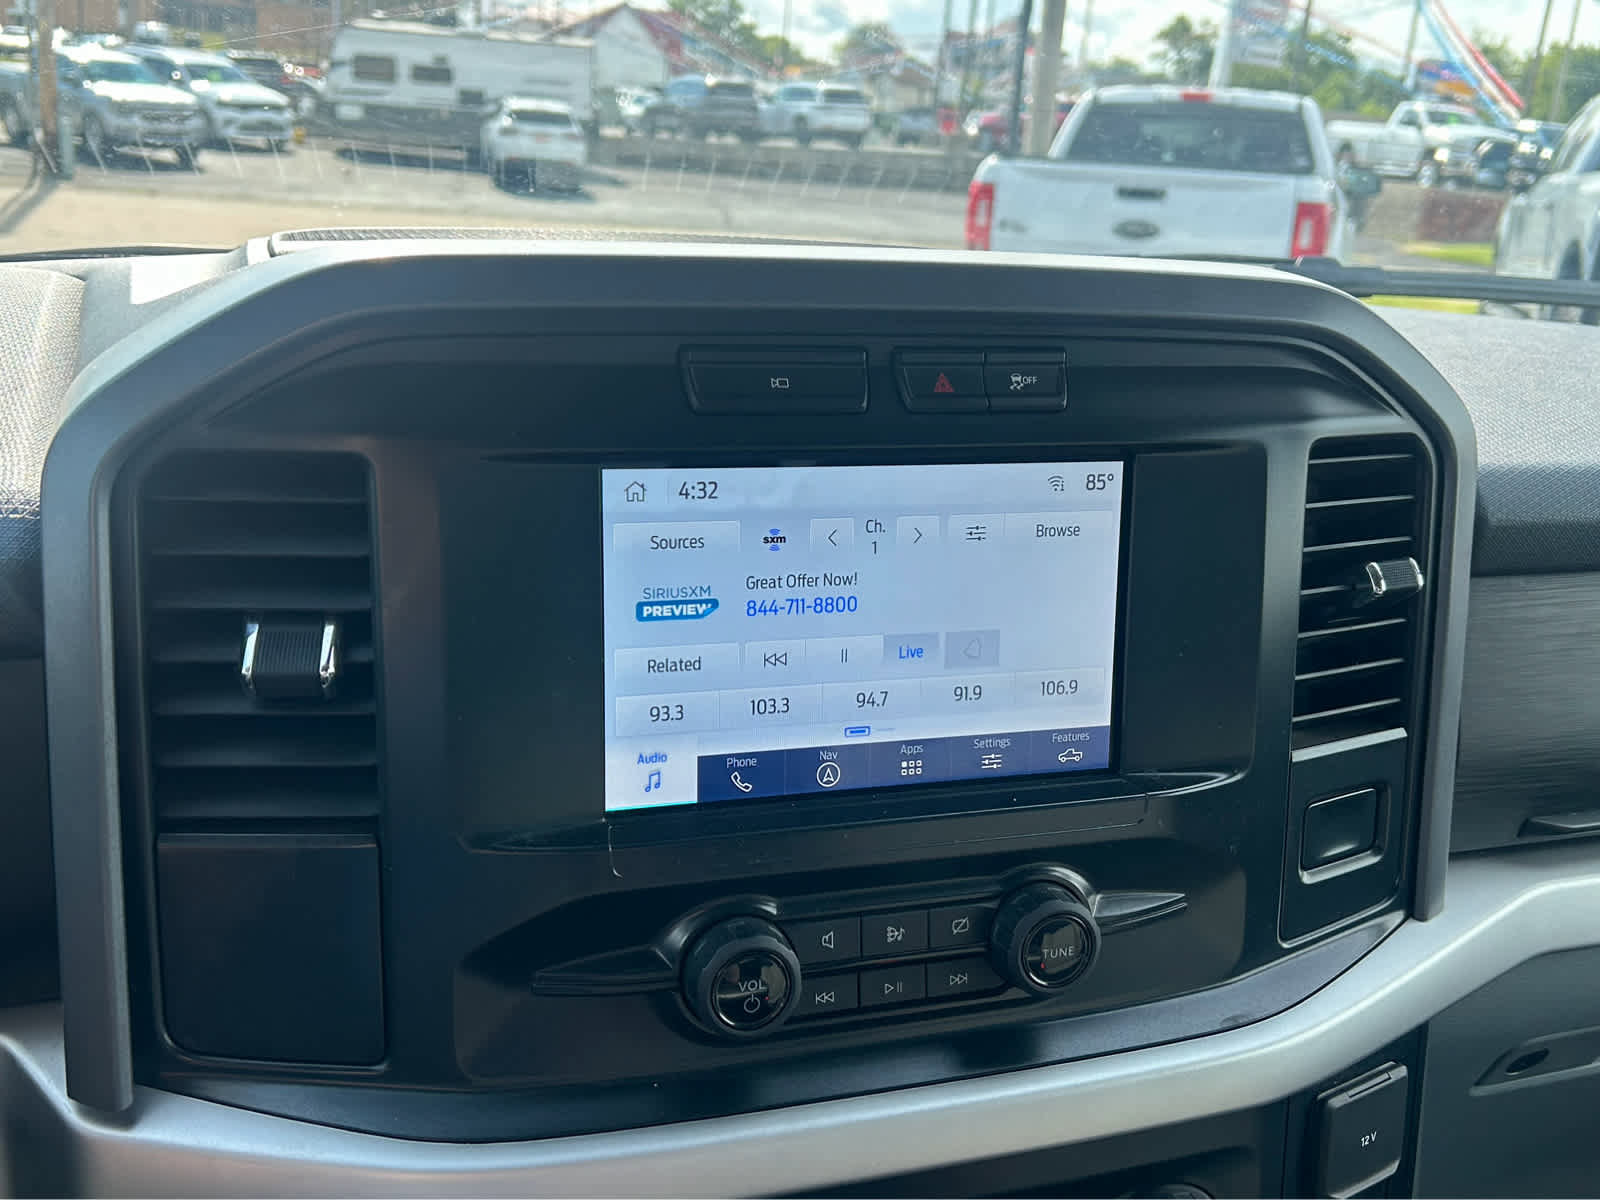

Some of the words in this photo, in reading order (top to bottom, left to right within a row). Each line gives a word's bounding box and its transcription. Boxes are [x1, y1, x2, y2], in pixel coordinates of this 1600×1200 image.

[1022, 376, 1038, 385] OFF
[1086, 473, 1114, 491] 85°
[678, 481, 718, 500] 4:32
[865, 519, 886, 534] Ch.
[1036, 523, 1081, 538] Browse
[650, 535, 705, 550] Sources
[763, 534, 786, 545] sxm
[871, 540, 877, 555] 1
[746, 575, 782, 590] Great
[786, 573, 819, 588] Offer
[823, 572, 858, 587] Now!
[642, 585, 712, 599] SIRIUSXM
[642, 603, 713, 618] PREVIEW
[746, 595, 858, 617] 844-711-8800
[898, 645, 924, 660] Live
[647, 656, 702, 674] Related
[954, 684, 982, 701] 91.9
[1041, 679, 1078, 696] 106.9
[750, 697, 790, 716] 103.3
[856, 691, 888, 708] 94.7
[649, 704, 684, 722] 93.3
[973, 736, 1011, 749] Settings
[1052, 731, 1090, 743] Features
[819, 750, 838, 760] Nav
[900, 743, 924, 755] Apps
[636, 751, 668, 765] Audio
[726, 757, 757, 769] Phone
[1041, 946, 1075, 960] TUNE
[738, 980, 767, 993] VOL
[1361, 1135, 1370, 1147] 12
[1370, 1131, 1377, 1142] V
